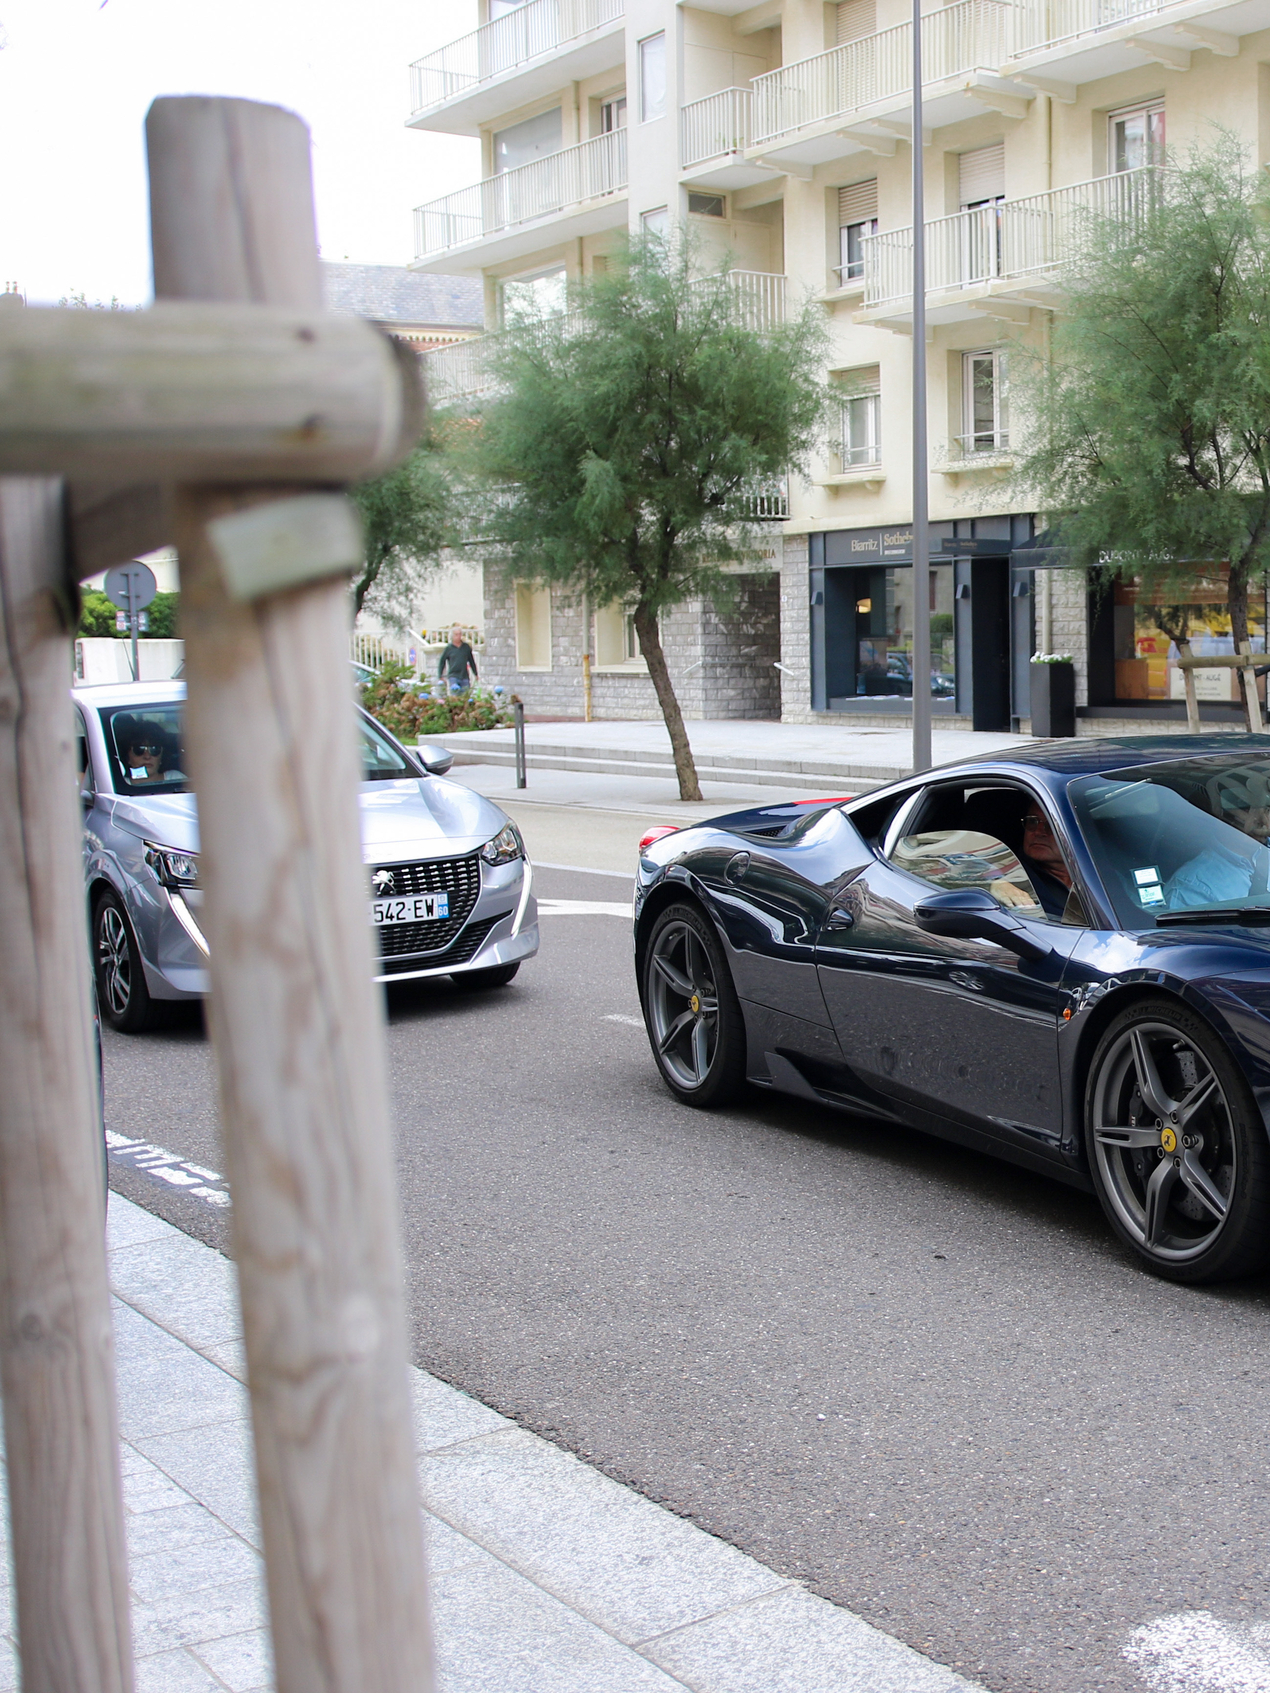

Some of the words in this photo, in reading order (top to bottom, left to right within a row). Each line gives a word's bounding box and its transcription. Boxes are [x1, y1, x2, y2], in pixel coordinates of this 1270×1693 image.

[851, 539, 878, 552] Biarritz
[373, 898, 435, 923] 542-EW
[438, 907, 448, 916] 60
